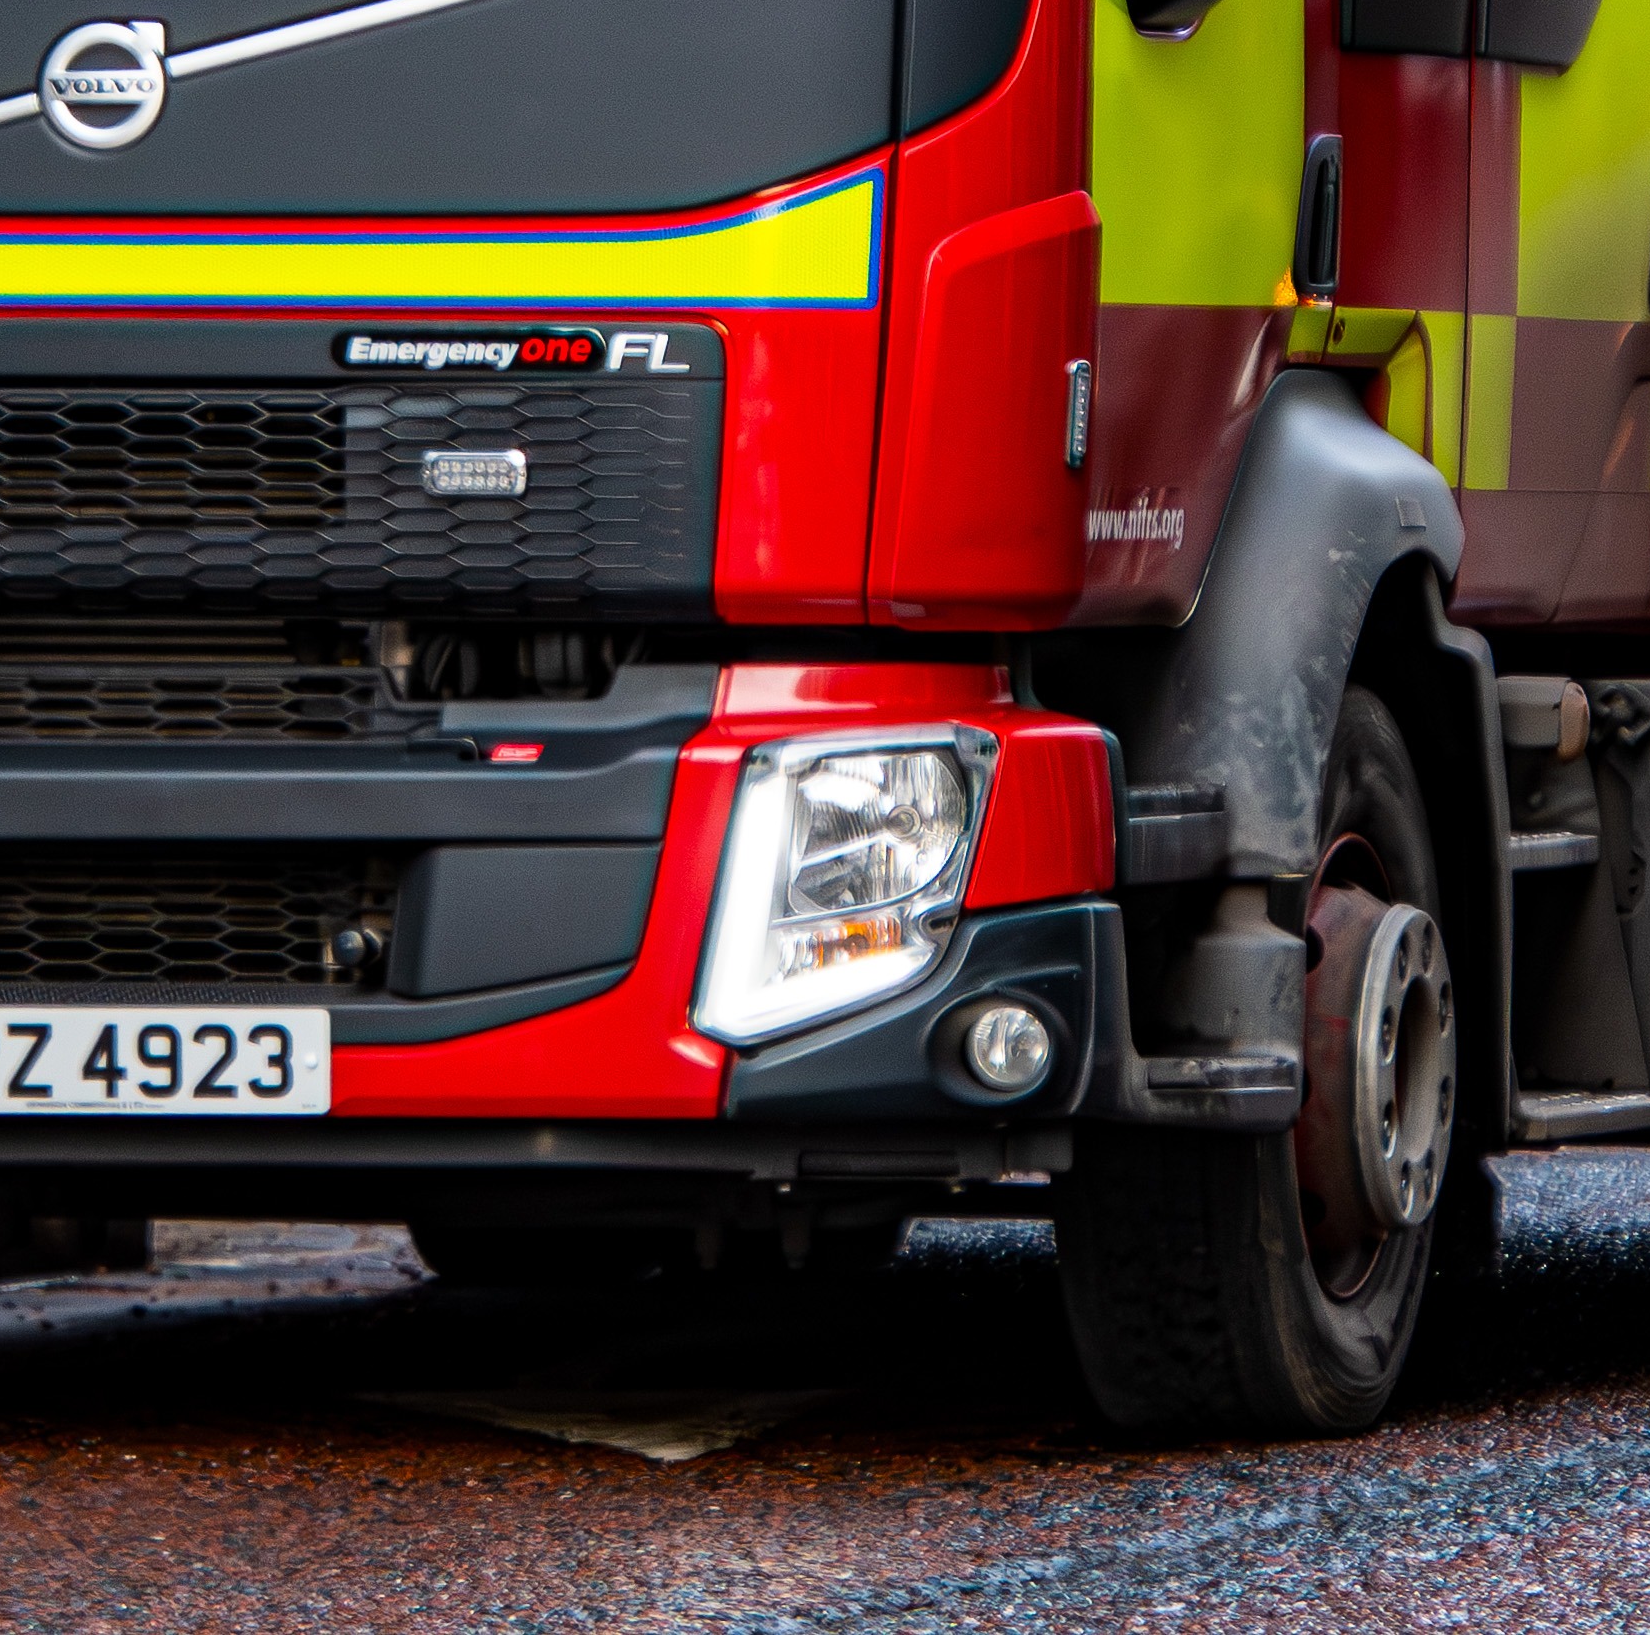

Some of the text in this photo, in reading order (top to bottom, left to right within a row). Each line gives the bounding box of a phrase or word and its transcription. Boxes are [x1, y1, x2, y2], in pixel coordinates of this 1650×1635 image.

[49, 77, 156, 95] VOLVO
[607, 333, 691, 374] FL
[1087, 496, 1185, 550] www.nifrs.org
[82, 1022, 295, 1100] 4923
